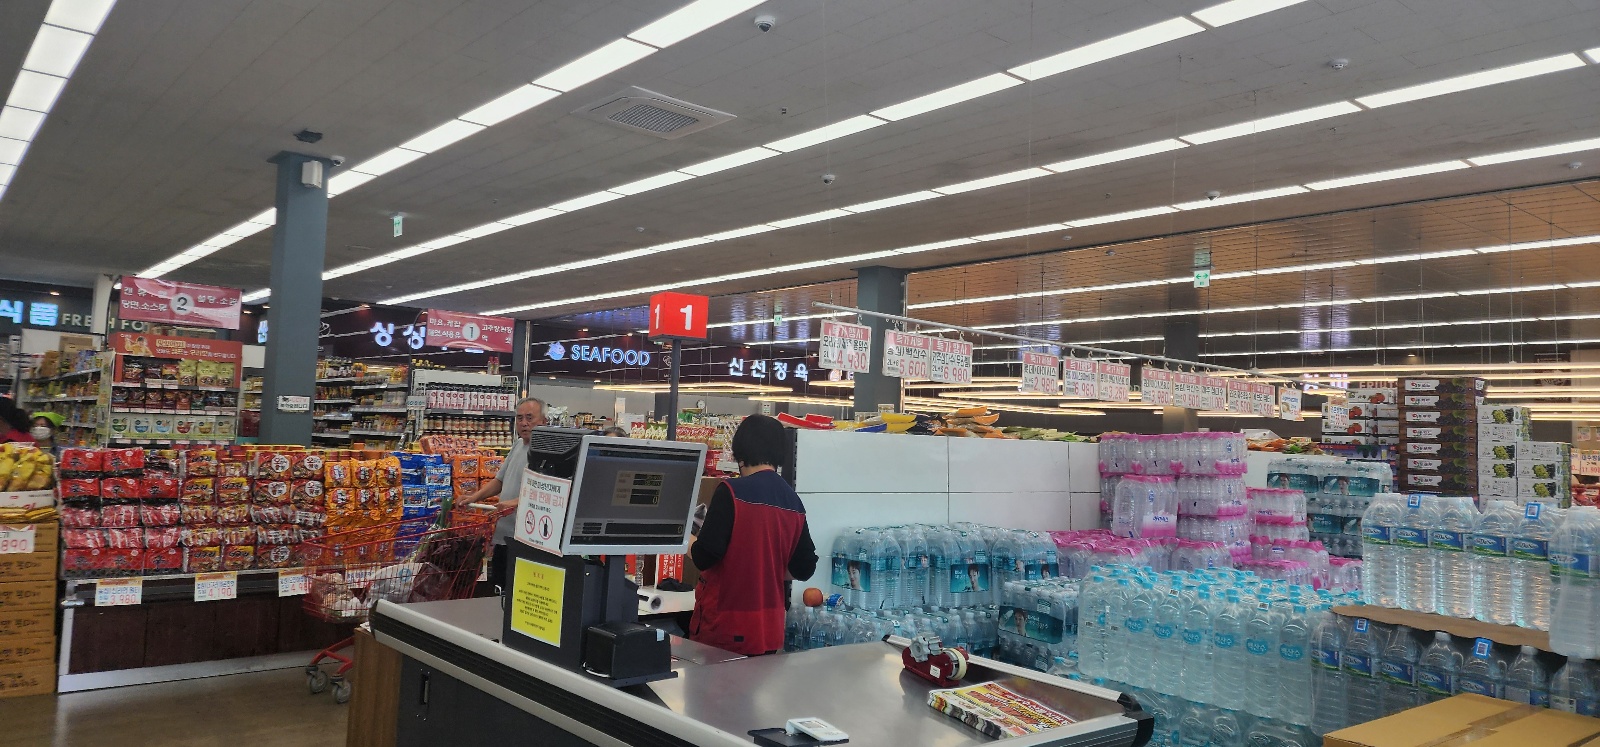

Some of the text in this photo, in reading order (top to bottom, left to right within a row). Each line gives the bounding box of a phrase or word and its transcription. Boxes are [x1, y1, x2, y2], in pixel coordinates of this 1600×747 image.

[176, 296, 187, 311] 2
[654, 303, 660, 329] 1
[680, 304, 692, 331] 1
[469, 326, 474, 338] 1
[571, 344, 651, 366] SEAFOOD
[111, 594, 138, 604] 3,980
